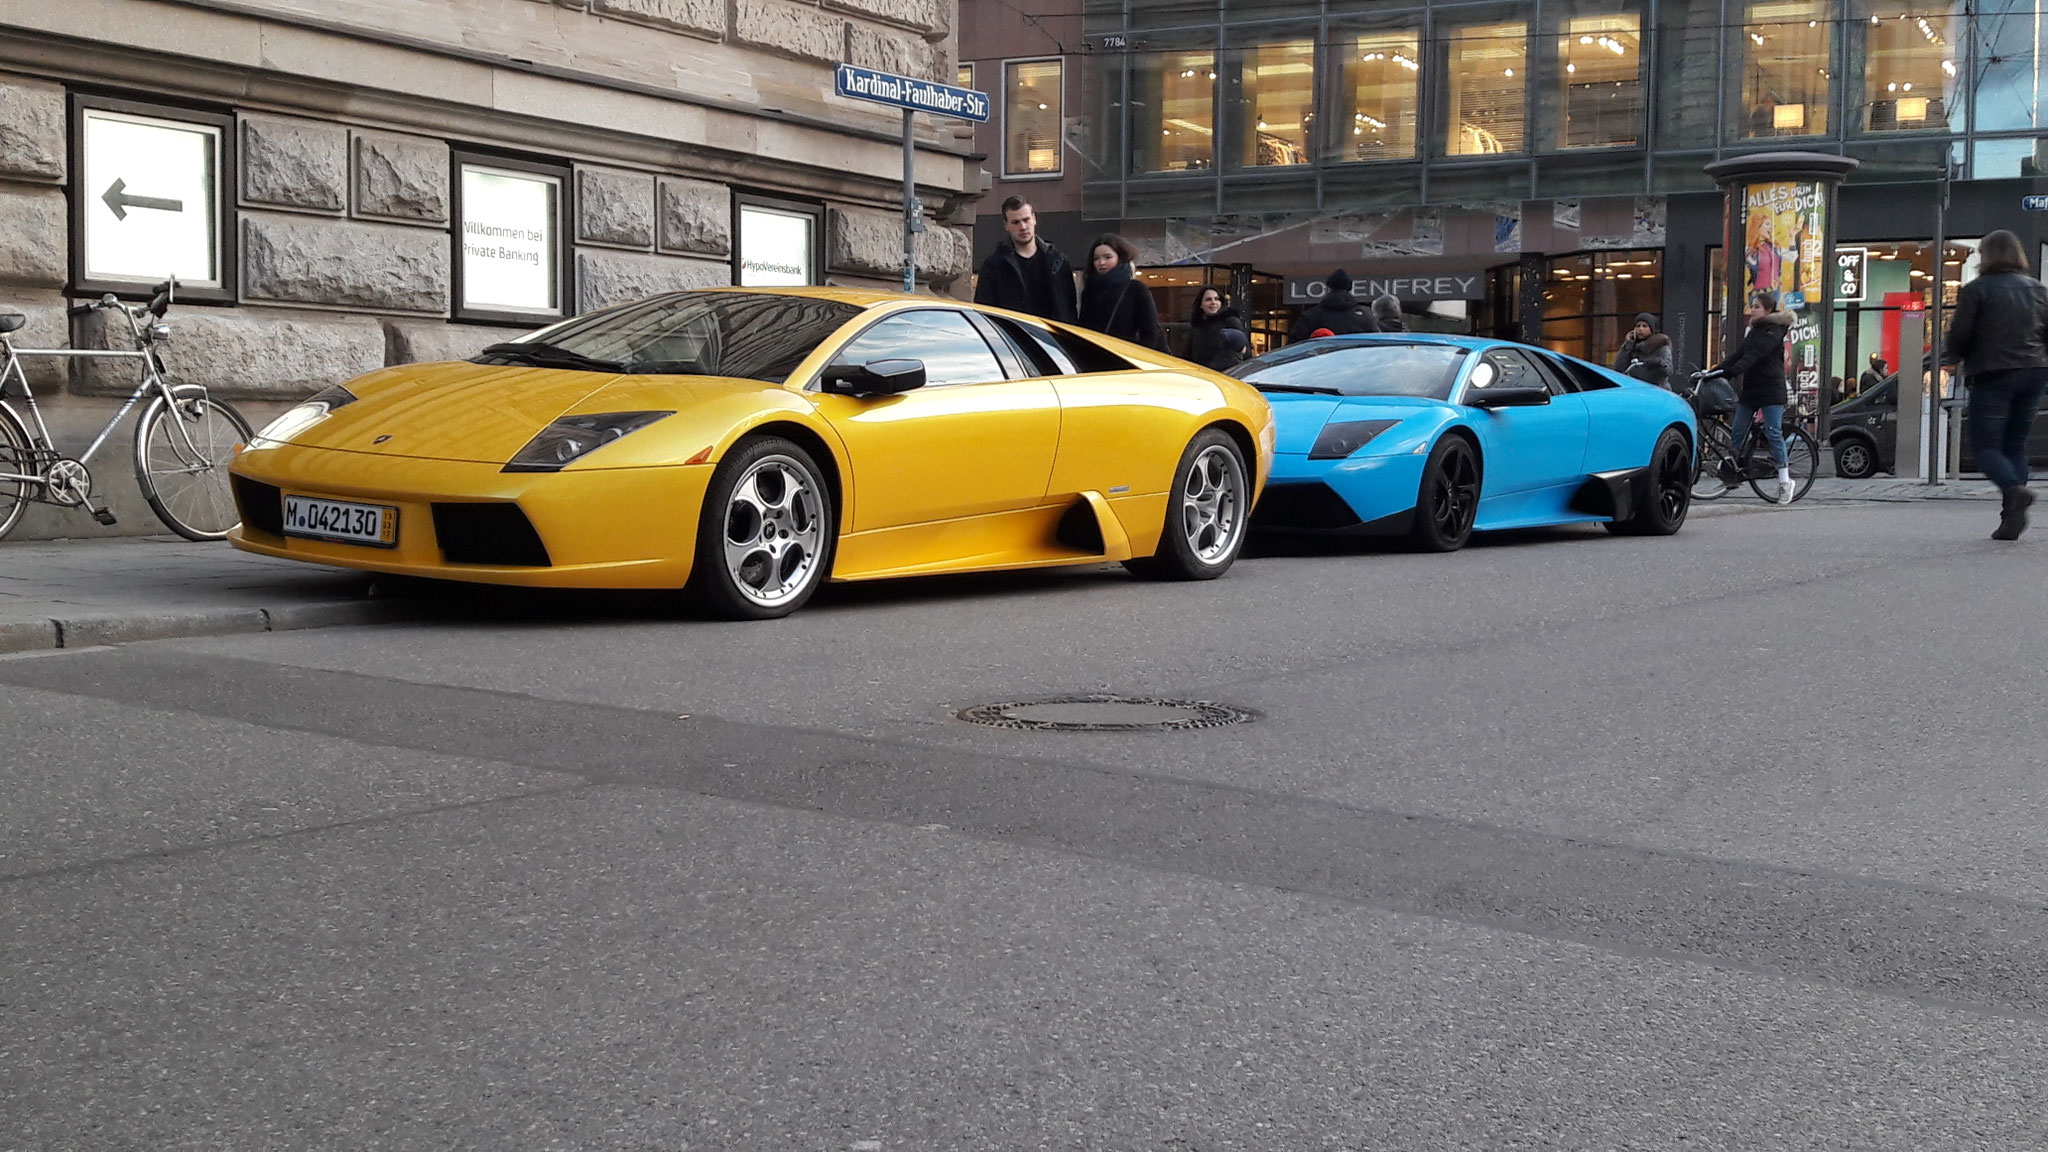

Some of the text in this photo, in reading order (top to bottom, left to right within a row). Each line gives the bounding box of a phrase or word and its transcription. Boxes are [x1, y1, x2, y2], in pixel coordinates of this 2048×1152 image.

[1104, 37, 1126, 48] 7784
[845, 68, 986, 116] Kardinal-Faulhaber-Str.
[1749, 186, 1788, 207] ALLES
[1791, 185, 1811, 198] DRIN
[1794, 192, 1824, 213] DICH!
[527, 228, 543, 242] bei
[498, 246, 539, 266] Banking
[1838, 255, 1860, 267] OFF
[746, 259, 802, 276] HypoVereinsbank
[1843, 269, 1855, 282] &
[1290, 276, 1476, 299] LOENFREY
[1840, 282, 1857, 295] CO
[1790, 323, 1819, 345] DICH!
